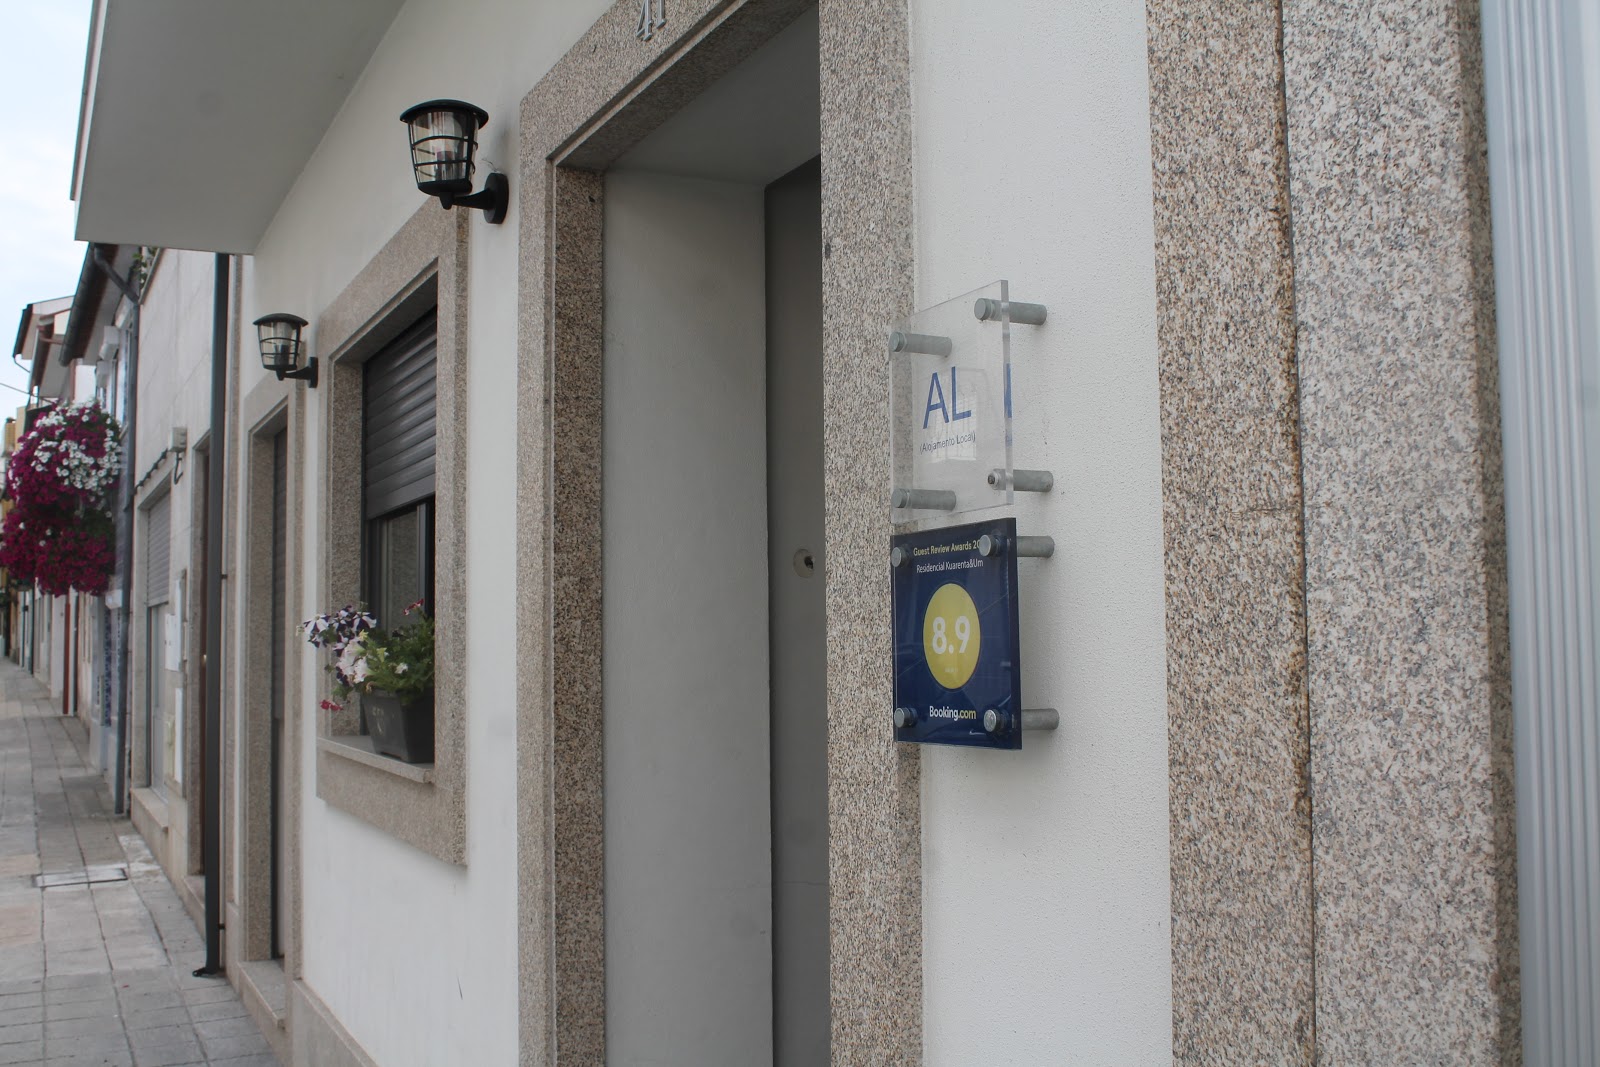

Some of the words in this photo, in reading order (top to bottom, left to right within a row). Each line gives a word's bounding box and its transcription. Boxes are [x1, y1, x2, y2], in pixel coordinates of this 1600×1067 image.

[923, 366, 972, 429] AL
[920, 436, 955, 455] (Alojamento
[956, 430, 976, 445] Local)
[913, 546, 930, 556] Guest
[930, 544, 950, 554] Review
[951, 541, 972, 552] Awards
[916, 562, 945, 573] Residencial
[932, 615, 971, 655] 8.9
[929, 705, 977, 721] Booking.com
